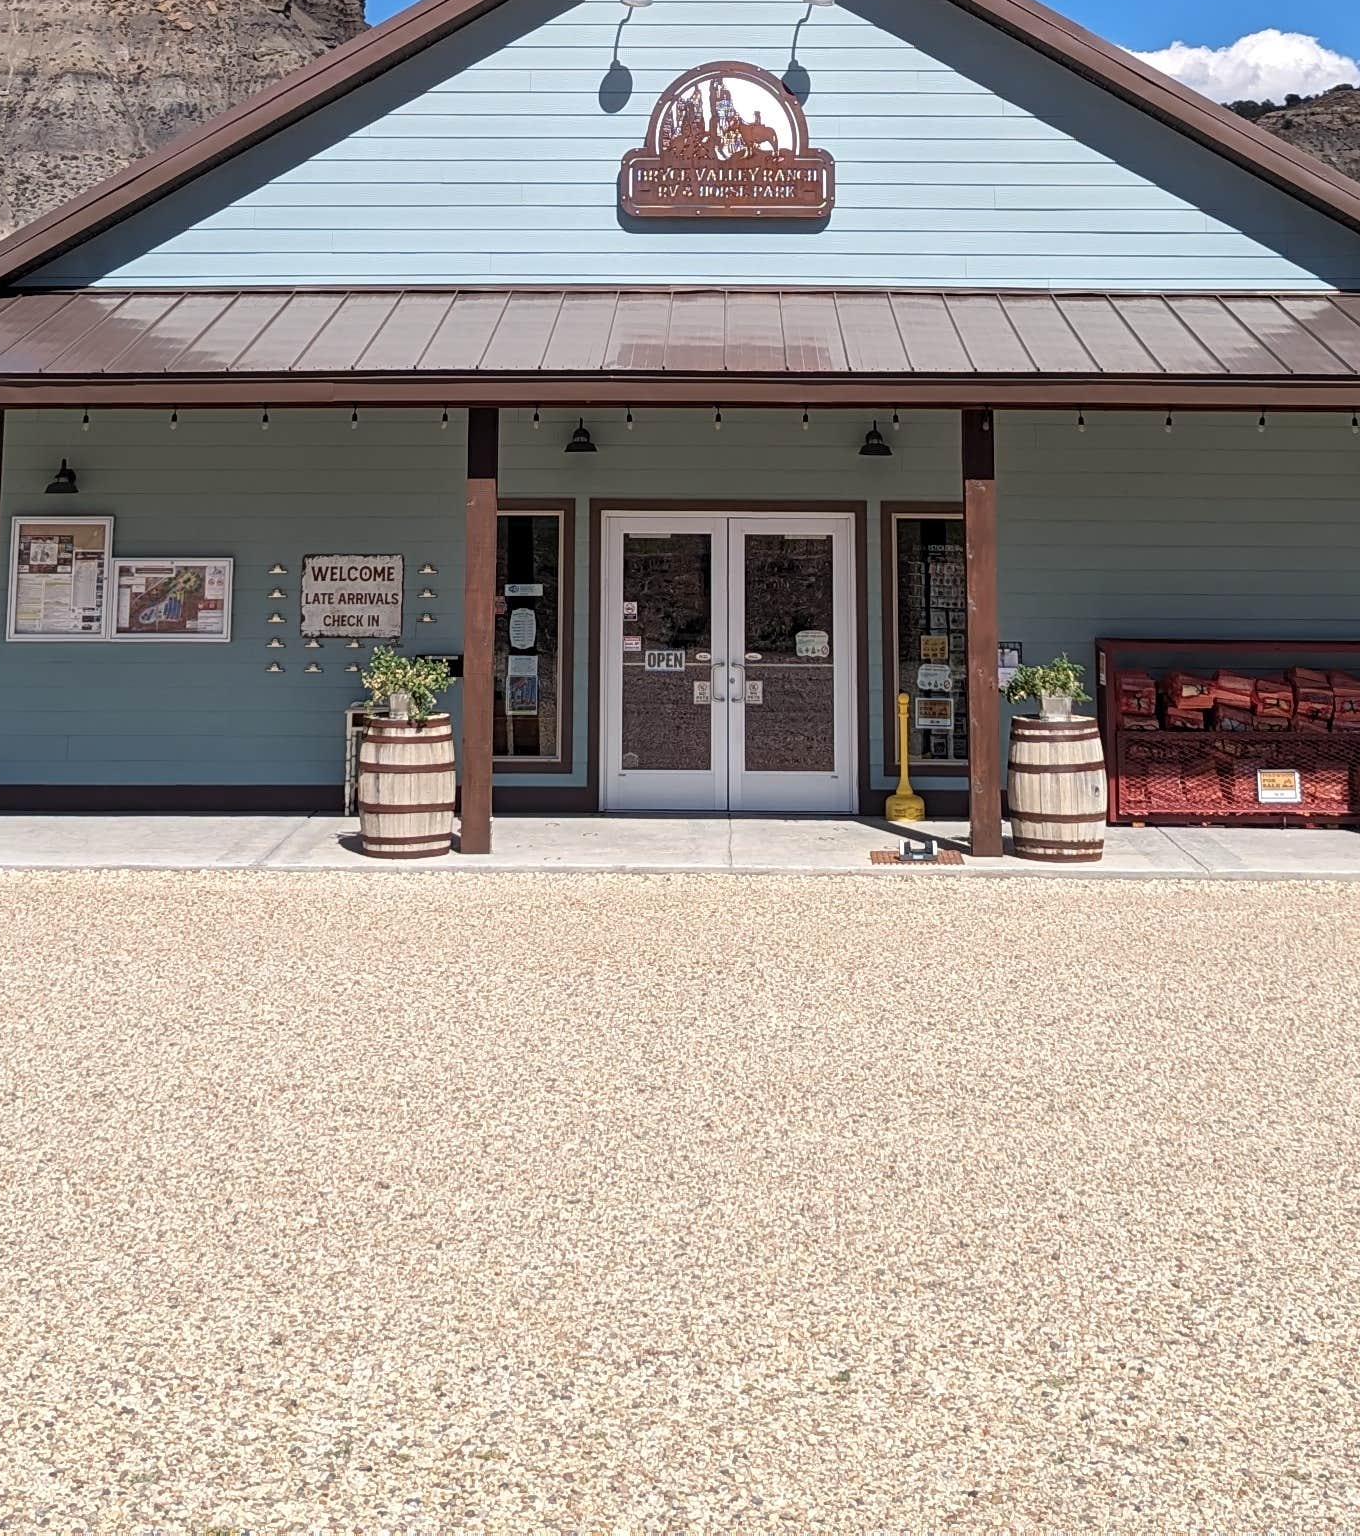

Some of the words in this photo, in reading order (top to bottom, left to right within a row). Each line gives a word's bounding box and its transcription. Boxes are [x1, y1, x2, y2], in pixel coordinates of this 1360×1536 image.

[637, 167, 689, 182] BRYCE
[695, 167, 760, 182] VALLEY
[762, 167, 818, 182] RANCH
[658, 184, 680, 198] RV
[699, 184, 749, 198] HORSE
[753, 185, 795, 198] PARK
[311, 566, 395, 581] WELCOME
[305, 593, 334, 604] LATE
[337, 593, 399, 604] ARRIVALS
[323, 615, 364, 627] CHECK
[367, 615, 380, 626] IN
[647, 652, 683, 668] OPEN
